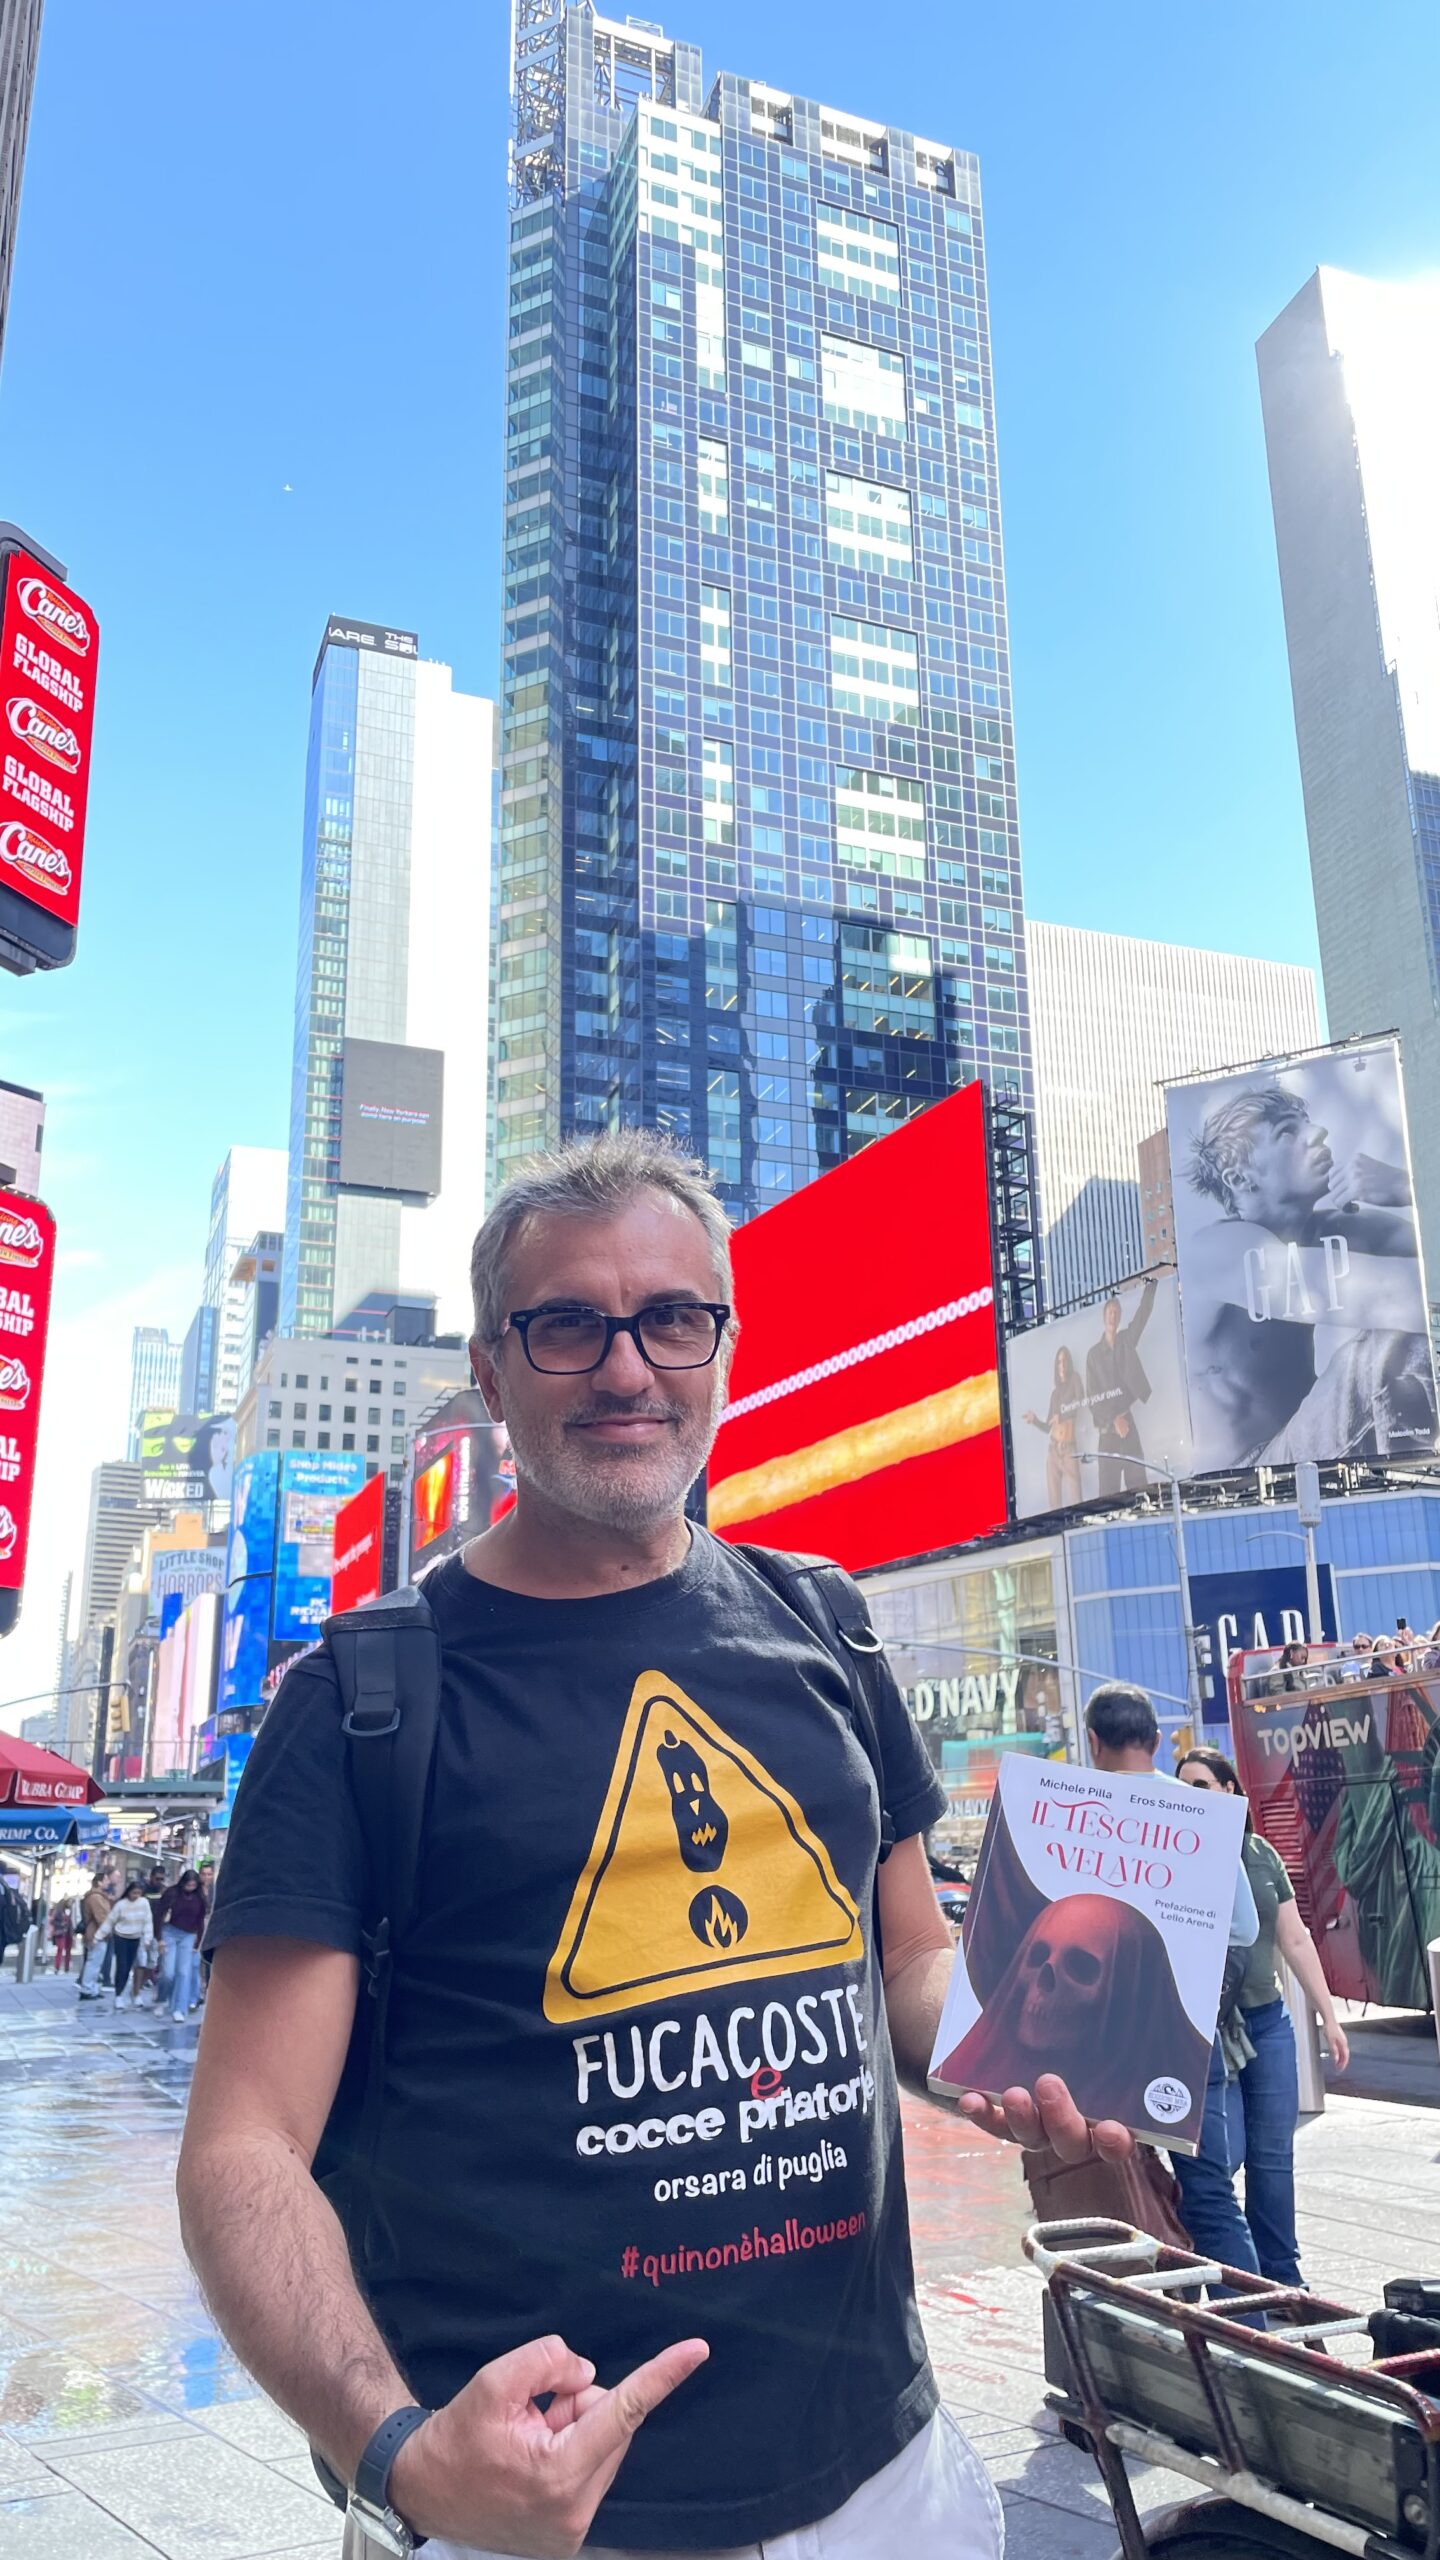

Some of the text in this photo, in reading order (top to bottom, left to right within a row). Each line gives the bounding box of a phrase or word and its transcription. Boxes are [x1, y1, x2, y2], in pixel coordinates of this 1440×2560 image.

[20, 579, 88, 640] Cane's
[15, 632, 84, 699] GLOBAL
[384, 632, 414, 644] THE
[13, 651, 84, 713] FLAGSHIP
[10, 700, 80, 756] Cane's
[2, 774, 75, 833] FLAGSHIP
[5, 754, 75, 818] GLOBAL
[0, 822, 69, 877] Cane's
[1243, 1235, 1350, 1323] GAP
[295, 1472, 349, 1485] Products
[160, 1552, 225, 1572] LITTLE SHOP
[939, 1667, 1020, 1718] NAVY
[1040, 1777, 1206, 1816] Michele Pilla Eros Santoro
[0, 1828, 32, 1840] RIMP
[1031, 1796, 1201, 1856] IL TESCHIO
[1046, 1842, 1173, 1890] VELATO
[1155, 1899, 1217, 1919] Prefazione di
[1161, 1911, 1215, 1930] Lello Arena
[572, 1984, 868, 2104] FUCACOSTE
[751, 2066, 784, 2100] e
[576, 2107, 726, 2156] cocce
[654, 2138, 848, 2202] orsara di puglia
[621, 2211, 866, 2288] #quinonèhalloween
